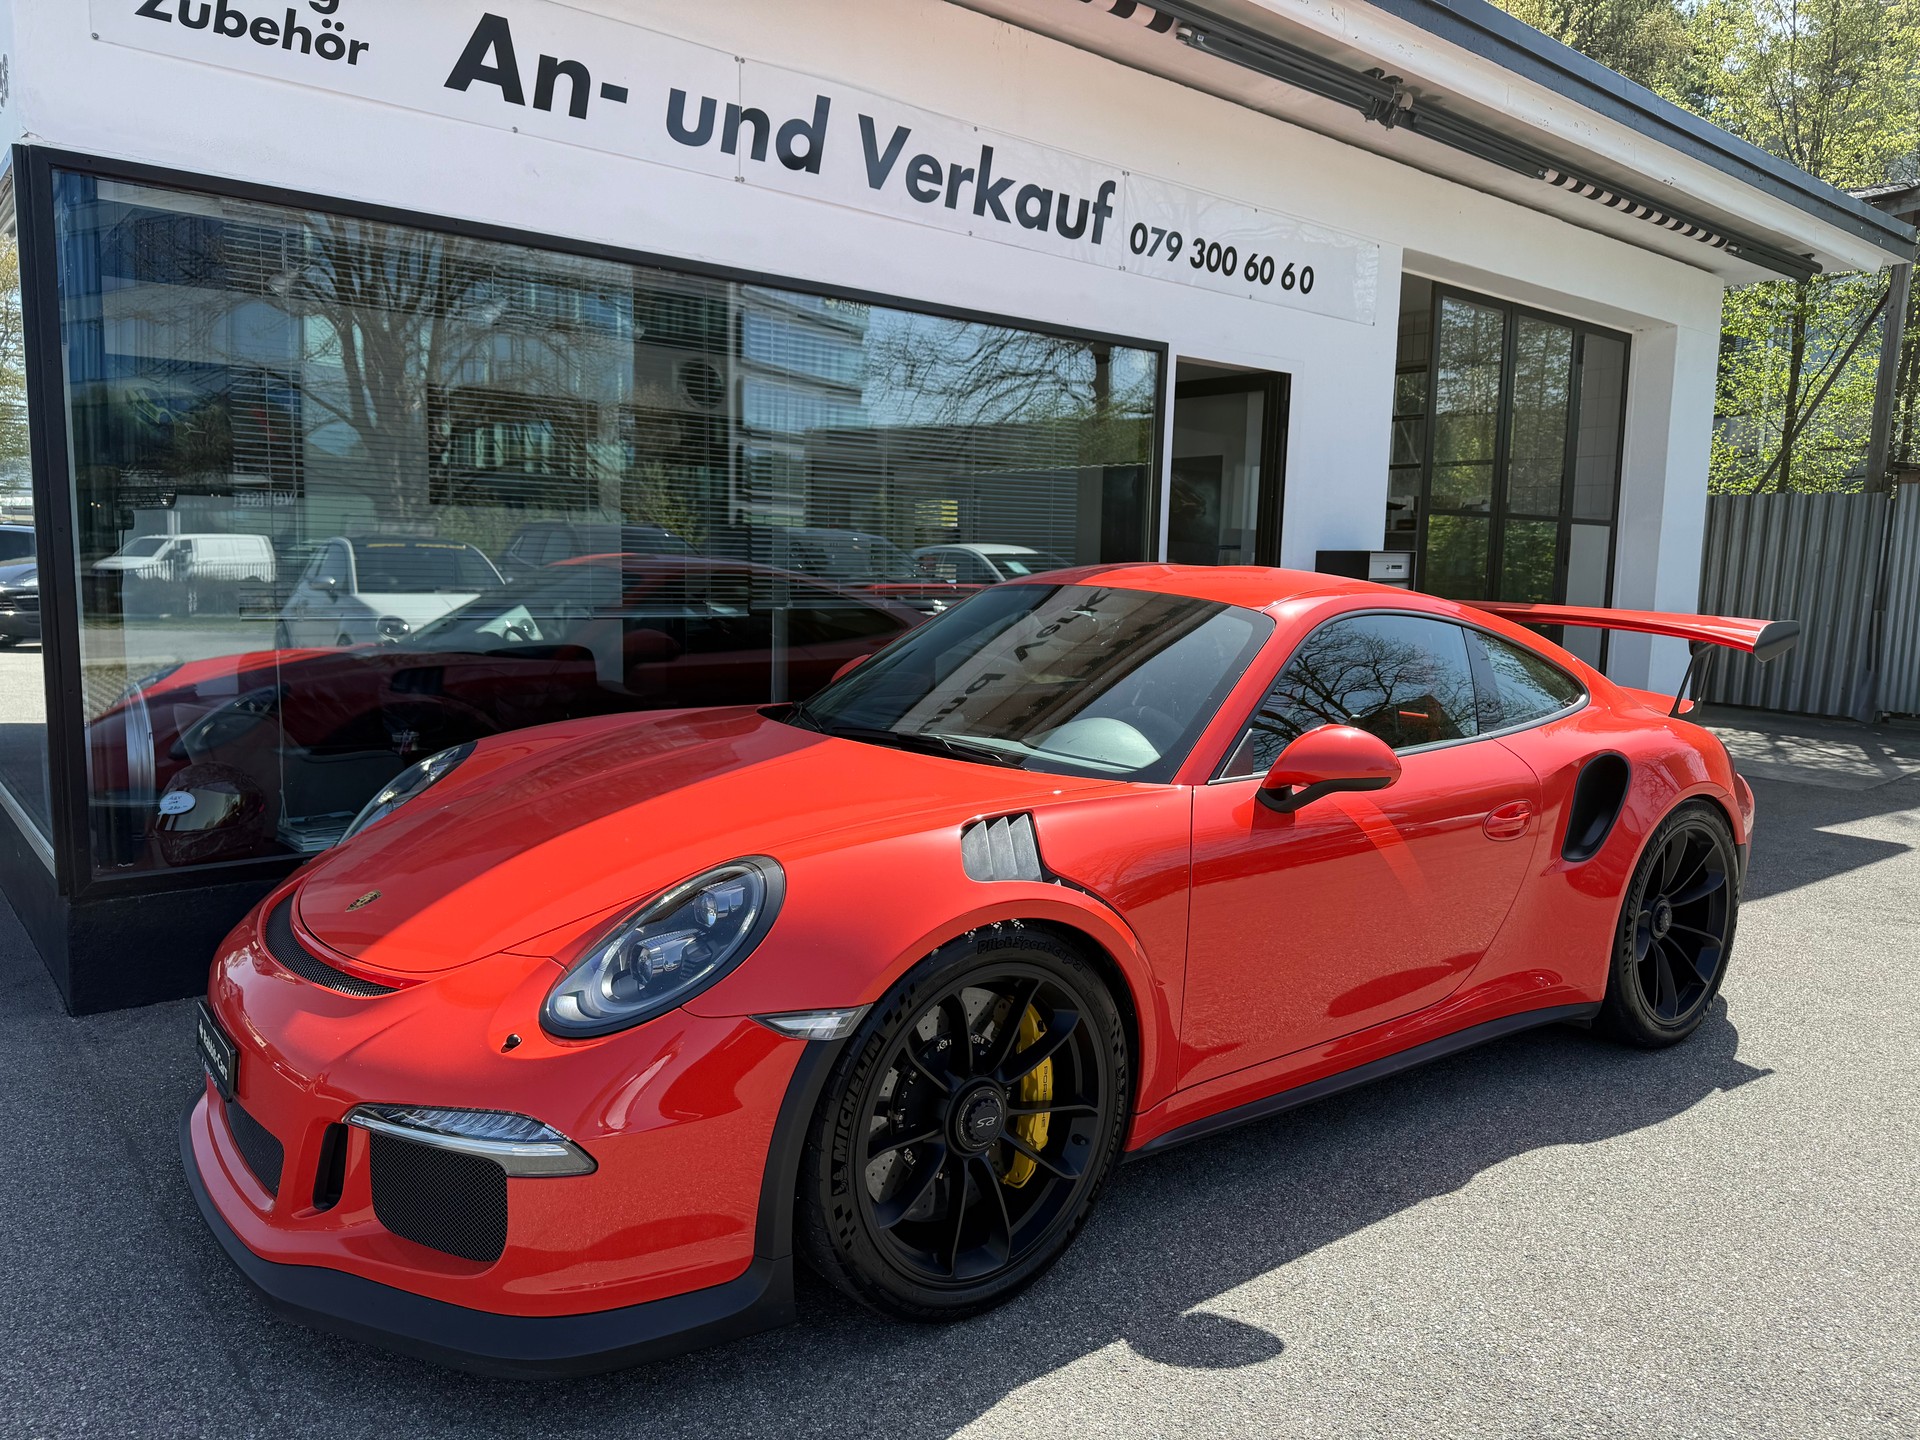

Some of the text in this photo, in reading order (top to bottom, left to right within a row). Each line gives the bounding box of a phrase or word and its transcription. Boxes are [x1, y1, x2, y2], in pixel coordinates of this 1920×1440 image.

[444, 13, 1117, 246] An- und Verkauf
[1129, 222, 1183, 262] 079
[1189, 237, 1238, 277] 300
[1243, 253, 1275, 286] 60
[977, 936, 1013, 954] Pilot
[1014, 935, 1051, 953] Sport
[1053, 945, 1073, 965] Cup
[832, 1030, 886, 1163] MICHELIN
[975, 1115, 997, 1129] RS
[1041, 1065, 1049, 1128] PORSHE
